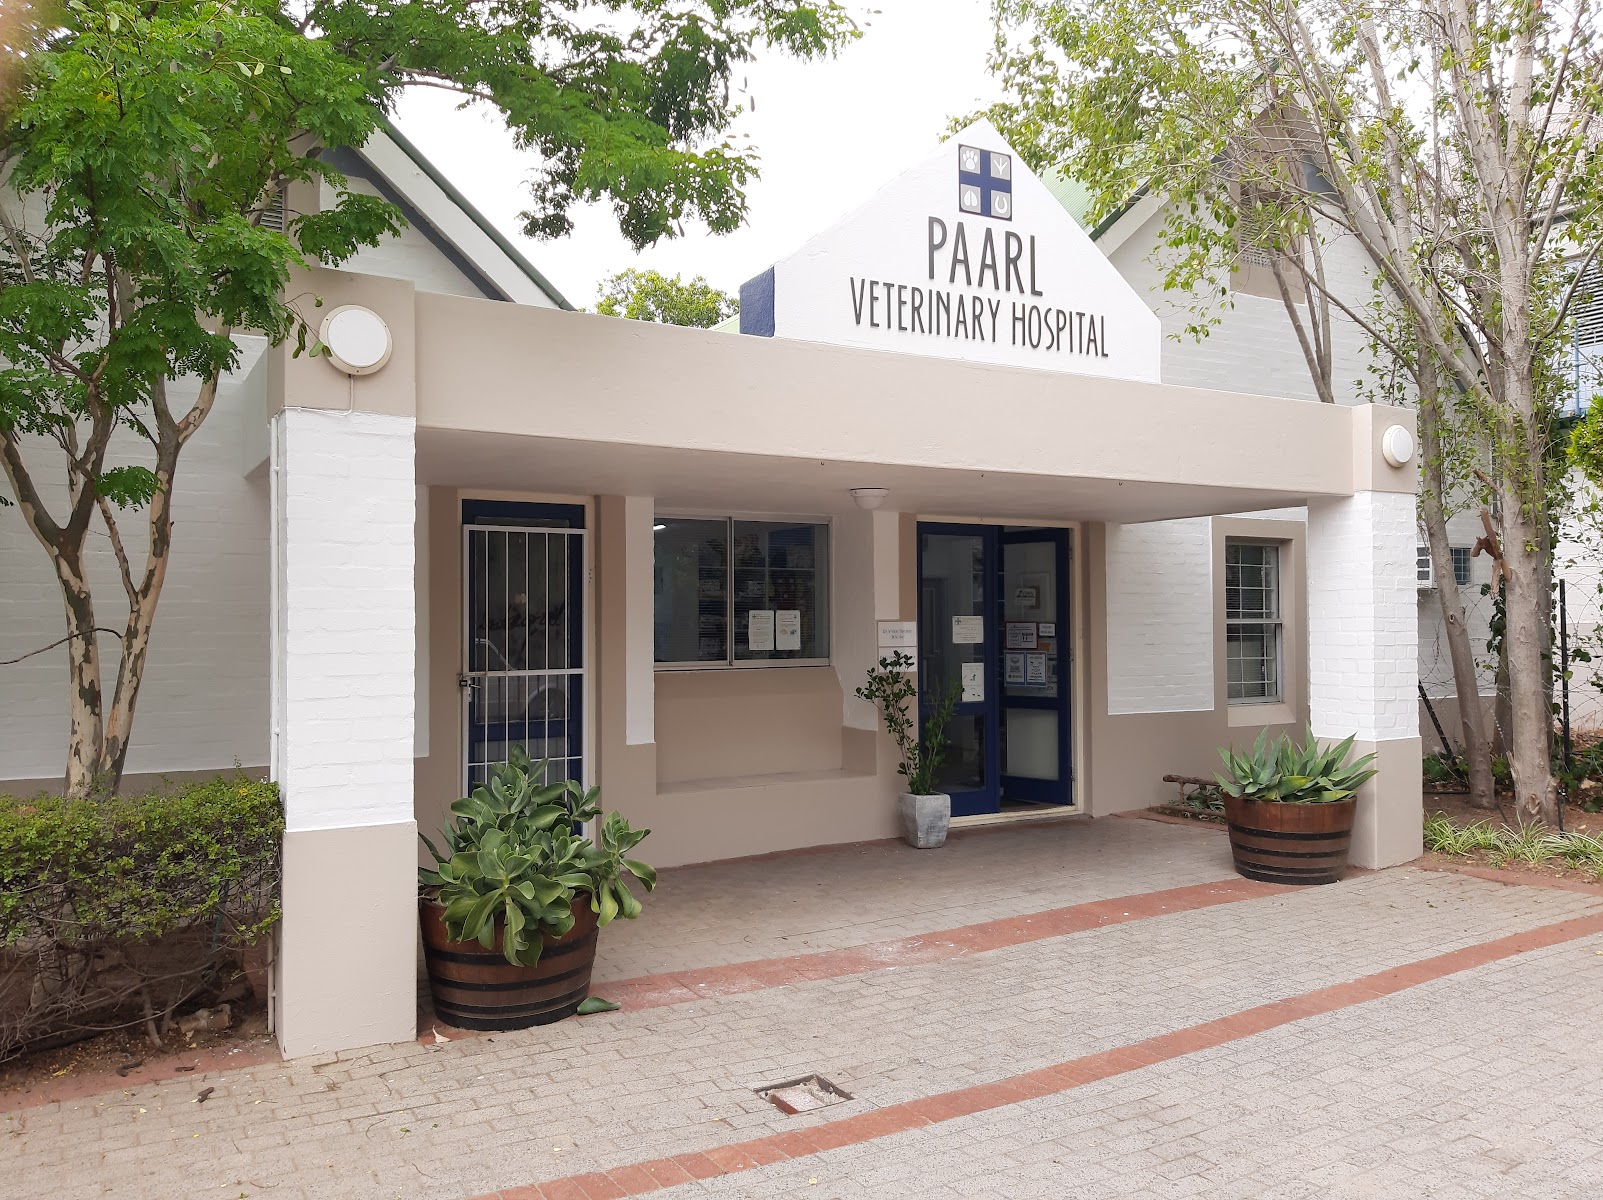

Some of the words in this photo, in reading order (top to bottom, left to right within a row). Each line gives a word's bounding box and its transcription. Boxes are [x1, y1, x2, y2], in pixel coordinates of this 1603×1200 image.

[928, 215, 1043, 297] PAARL
[850, 276, 1001, 343] VETERINARY
[1012, 301, 1109, 358] HOSPITAL
